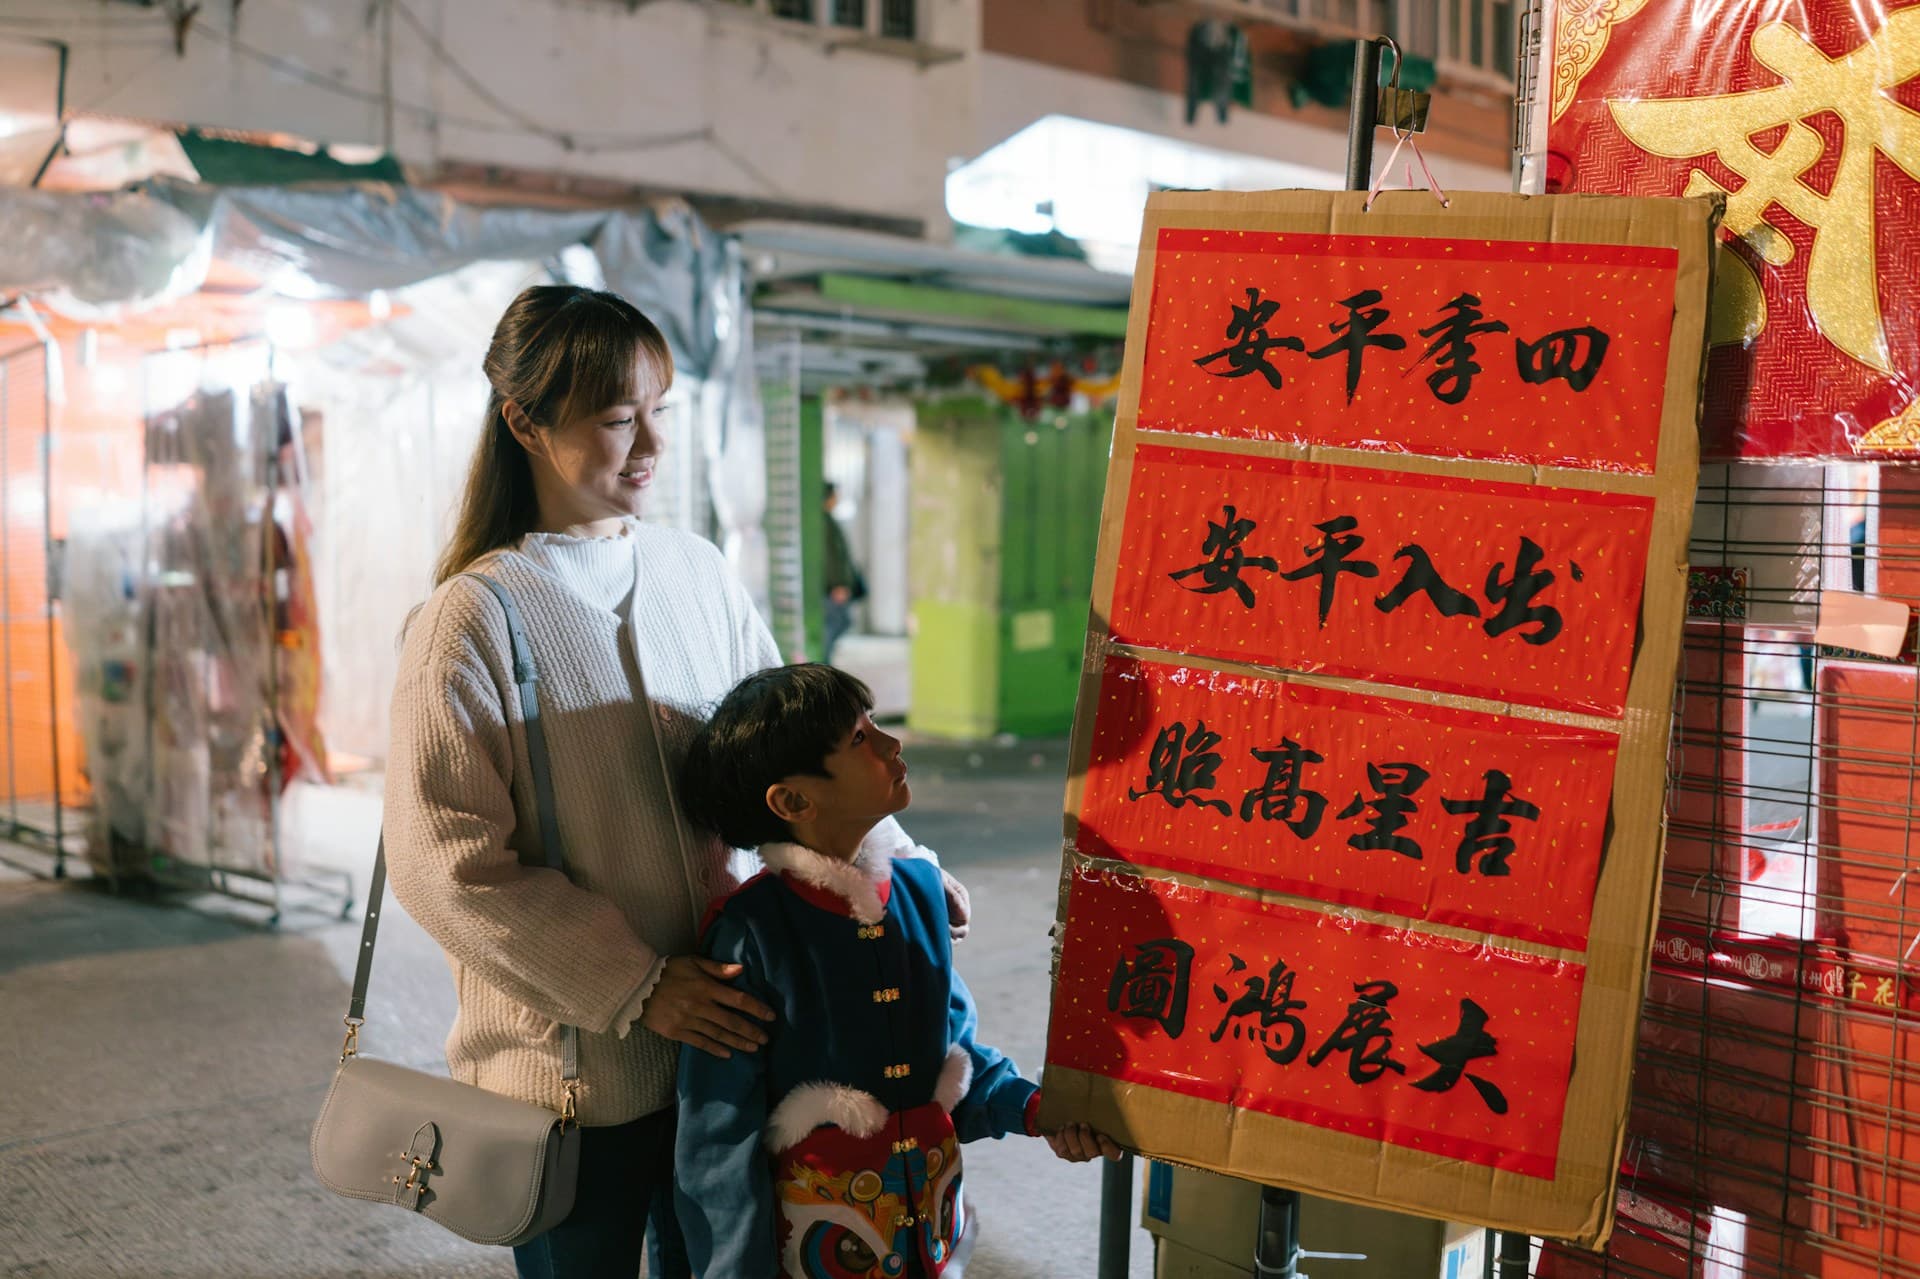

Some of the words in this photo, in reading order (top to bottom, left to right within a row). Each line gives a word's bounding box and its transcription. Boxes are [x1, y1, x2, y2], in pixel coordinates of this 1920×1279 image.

[1194, 288, 1609, 404] 四季平安
[1168, 506, 1582, 645] 出入平安
